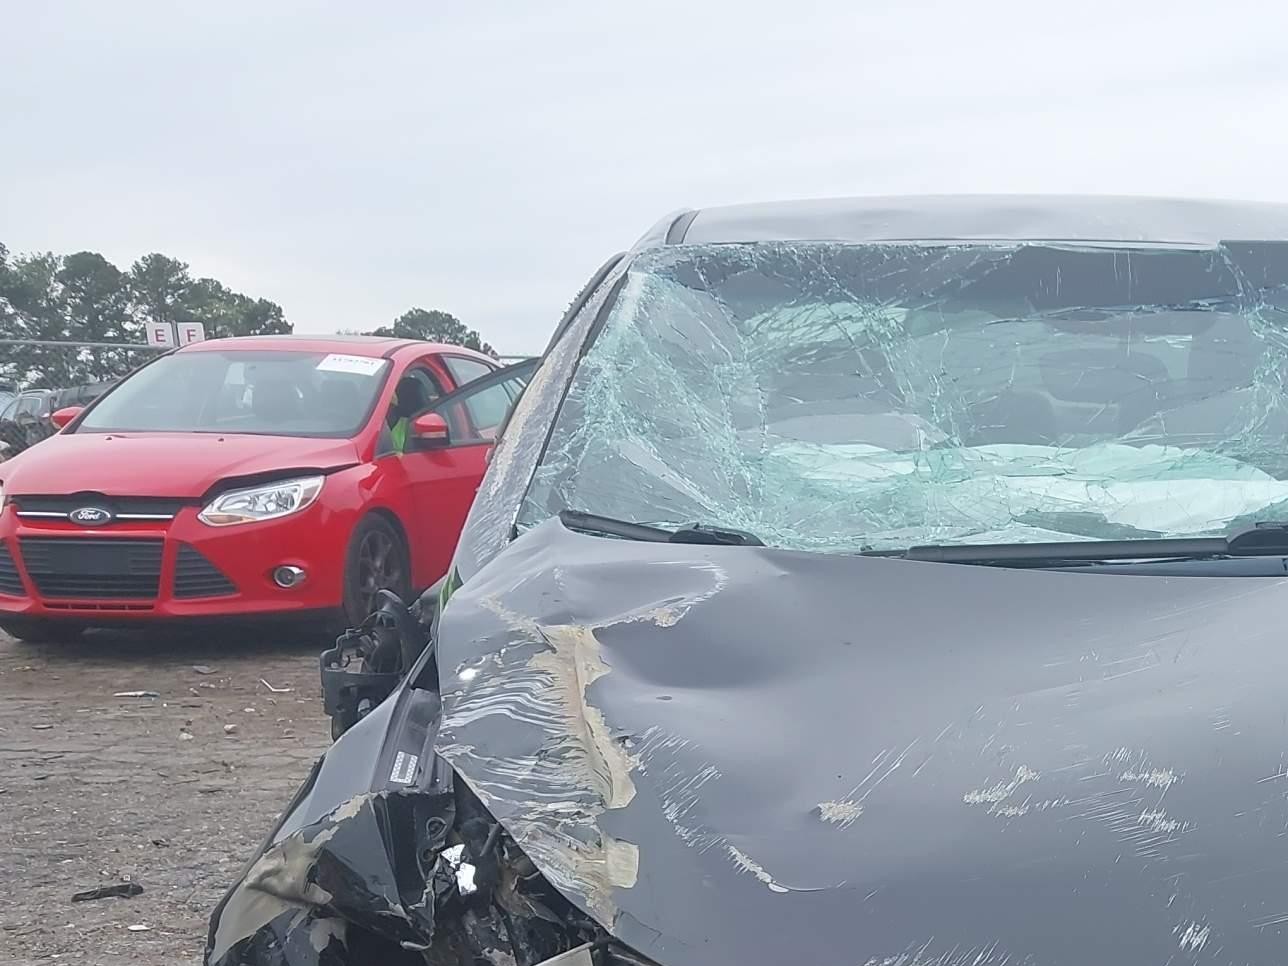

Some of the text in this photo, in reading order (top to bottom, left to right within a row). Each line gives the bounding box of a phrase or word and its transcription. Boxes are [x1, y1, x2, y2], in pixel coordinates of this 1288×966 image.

[155, 329, 166, 342] E
[186, 329, 196, 342] F
[78, 510, 101, 520] Ford
